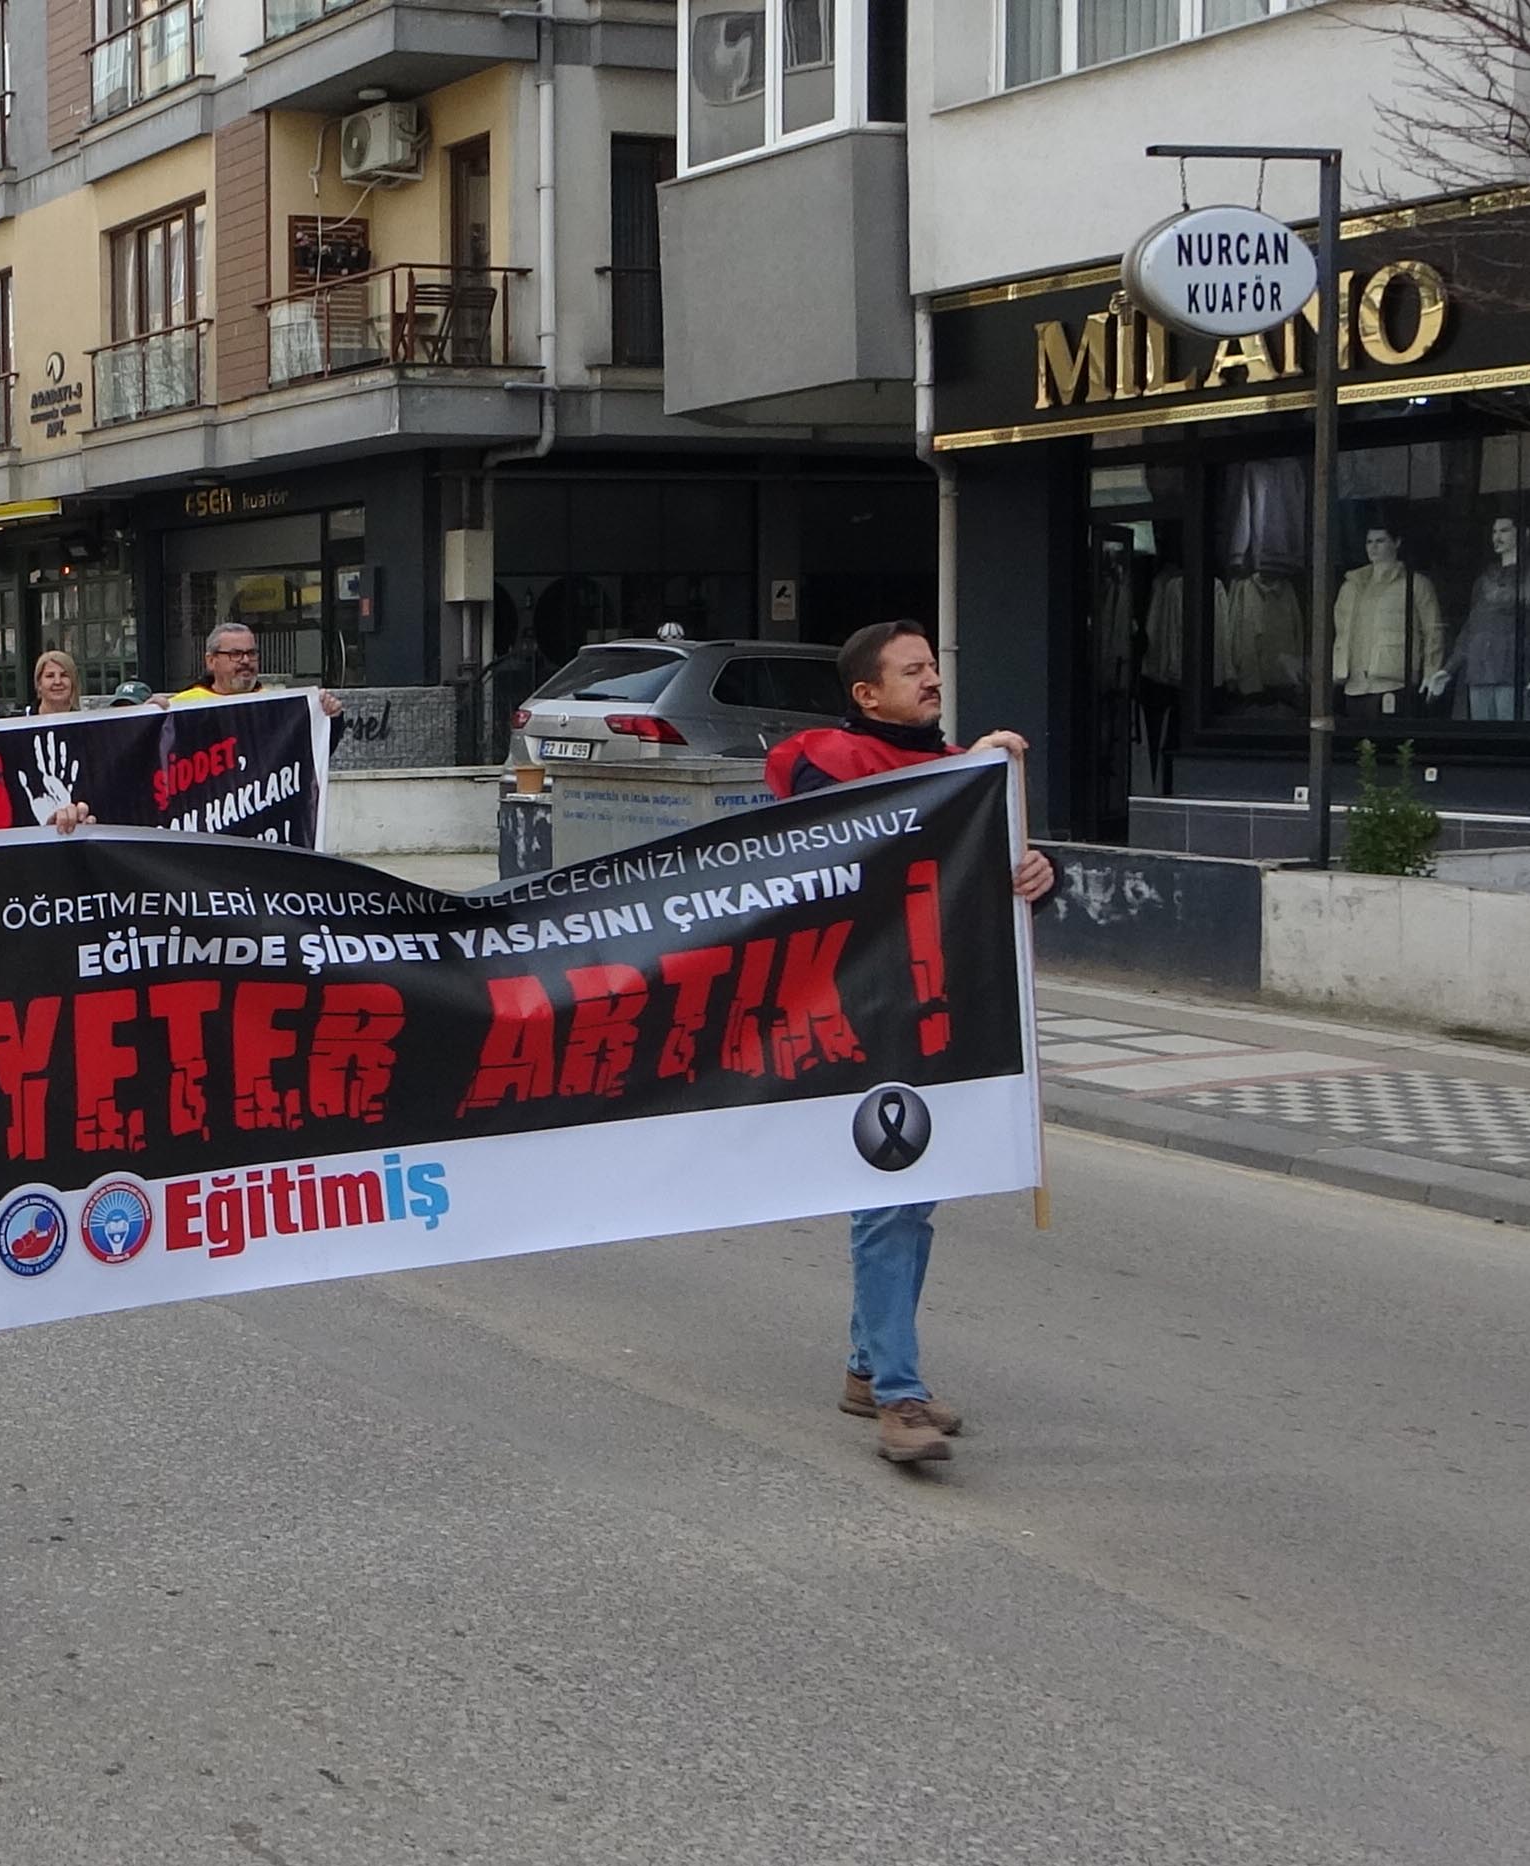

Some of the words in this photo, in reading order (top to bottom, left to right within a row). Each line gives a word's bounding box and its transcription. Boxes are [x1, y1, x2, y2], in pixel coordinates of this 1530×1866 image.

[1176, 232, 1289, 267] NURCAN
[1187, 275, 1283, 314] KUAFÖR
[153, 737, 247, 811] ŞİDDET,
[205, 761, 301, 834] HAKLARI
[714, 794, 748, 807] EVSEL
[1, 887, 256, 931] ÖĞRETMENLERİ
[268, 891, 458, 918] KORURSANIZ
[697, 808, 923, 871] KORURSUNUZ
[78, 926, 287, 977] EĞİTİMDE
[299, 924, 440, 975] ŞİDDET
[449, 902, 654, 961] YASASINI
[664, 862, 863, 932] ÇIKARTIN
[456, 920, 866, 1119] ARTIK
